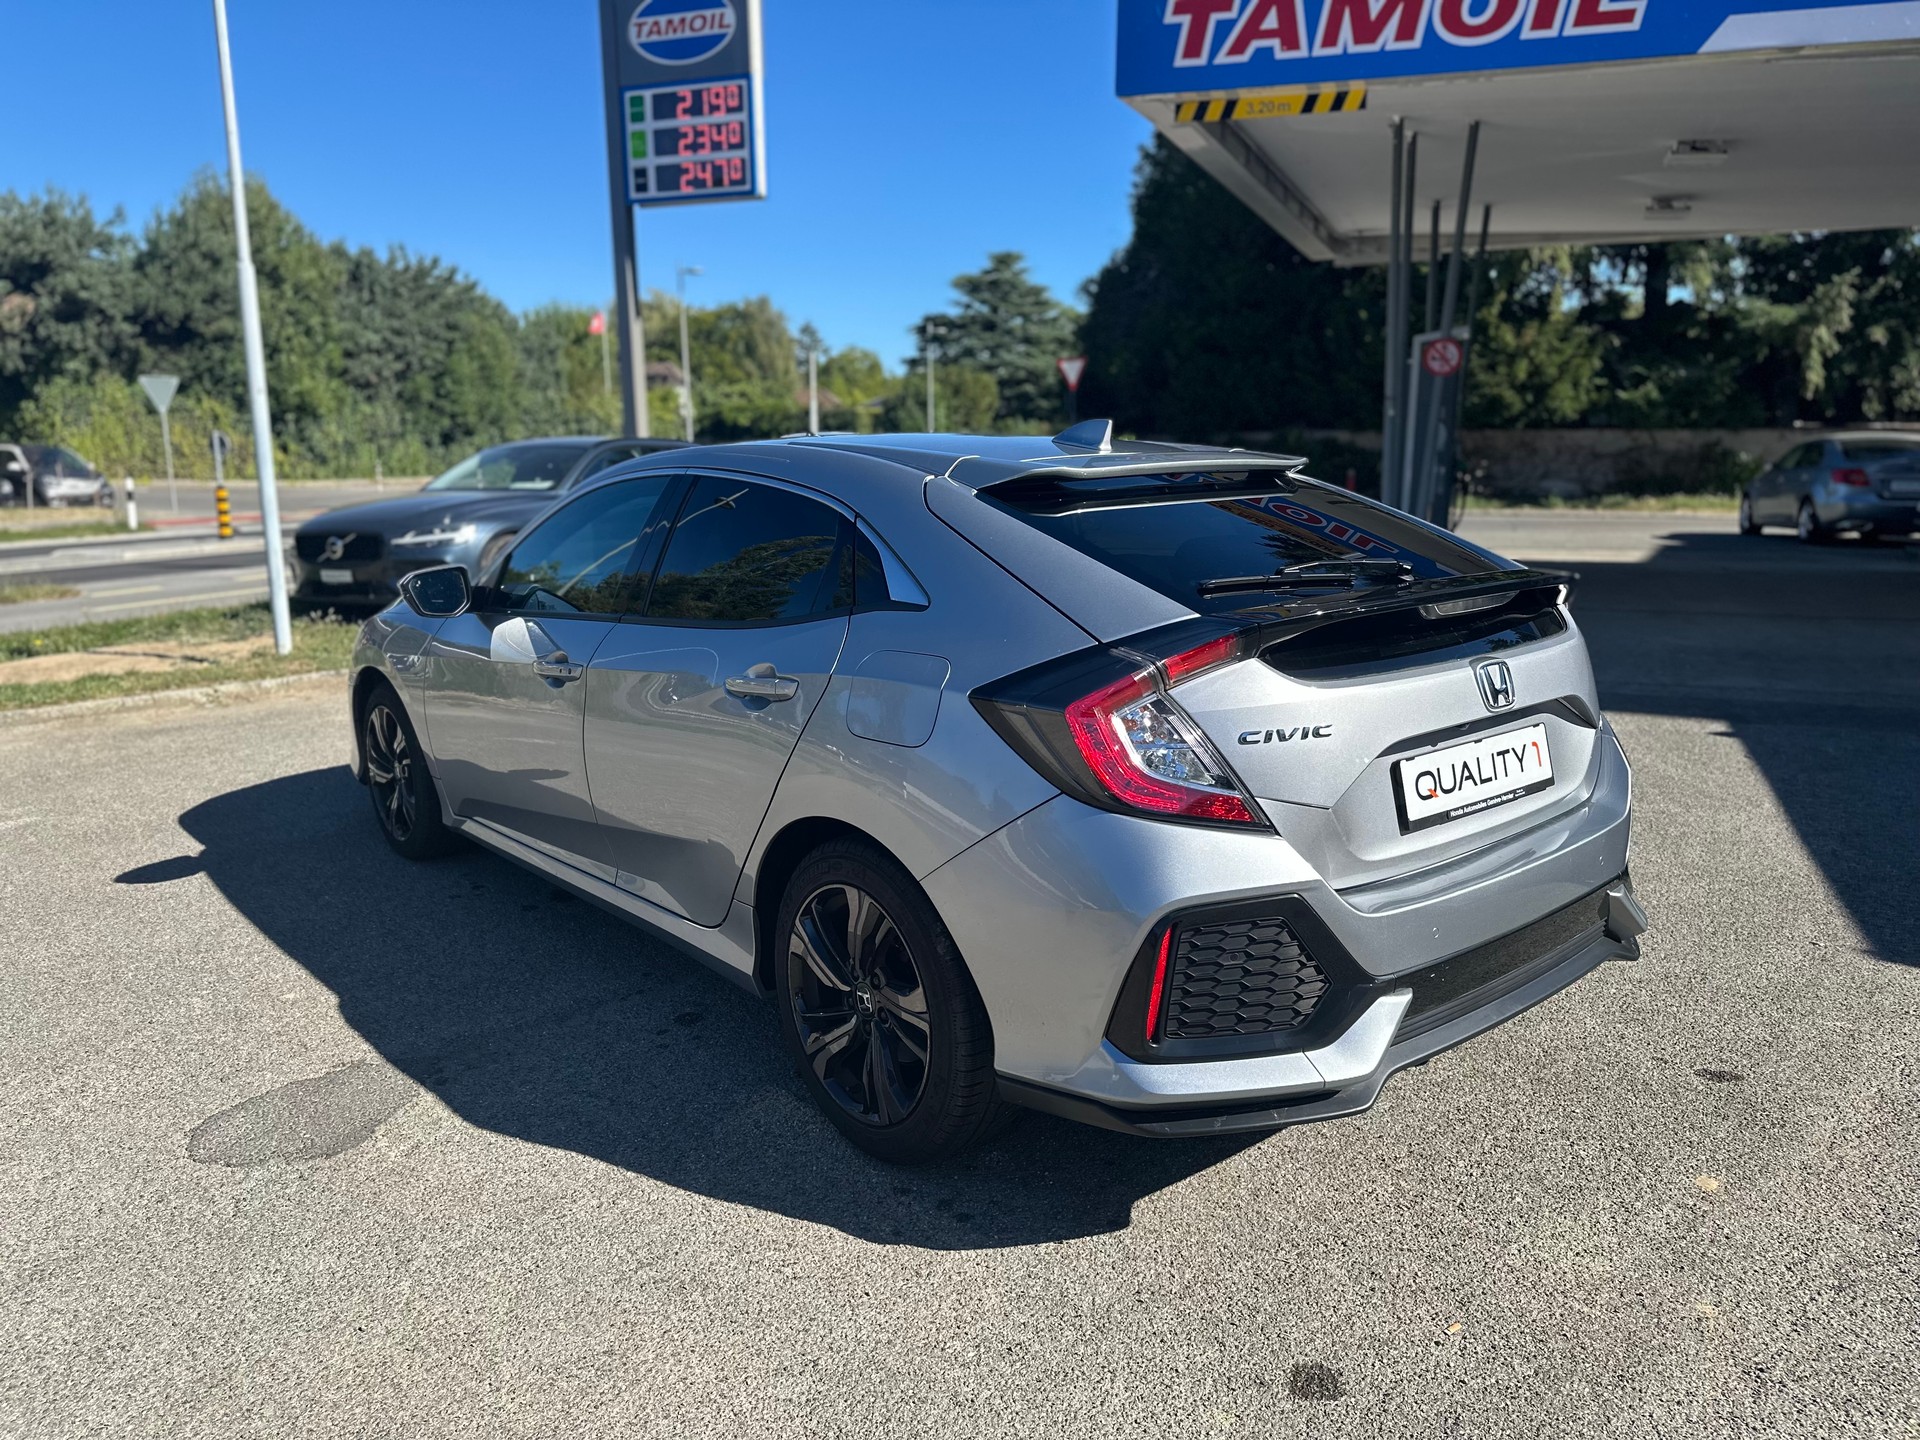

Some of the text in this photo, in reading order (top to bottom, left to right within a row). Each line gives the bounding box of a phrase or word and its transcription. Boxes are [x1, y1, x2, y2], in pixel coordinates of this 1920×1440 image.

[633, 12, 732, 39] TAMOIL
[1247, 101, 1292, 115] 3.20 m
[1237, 724, 1333, 745] CIVIC
